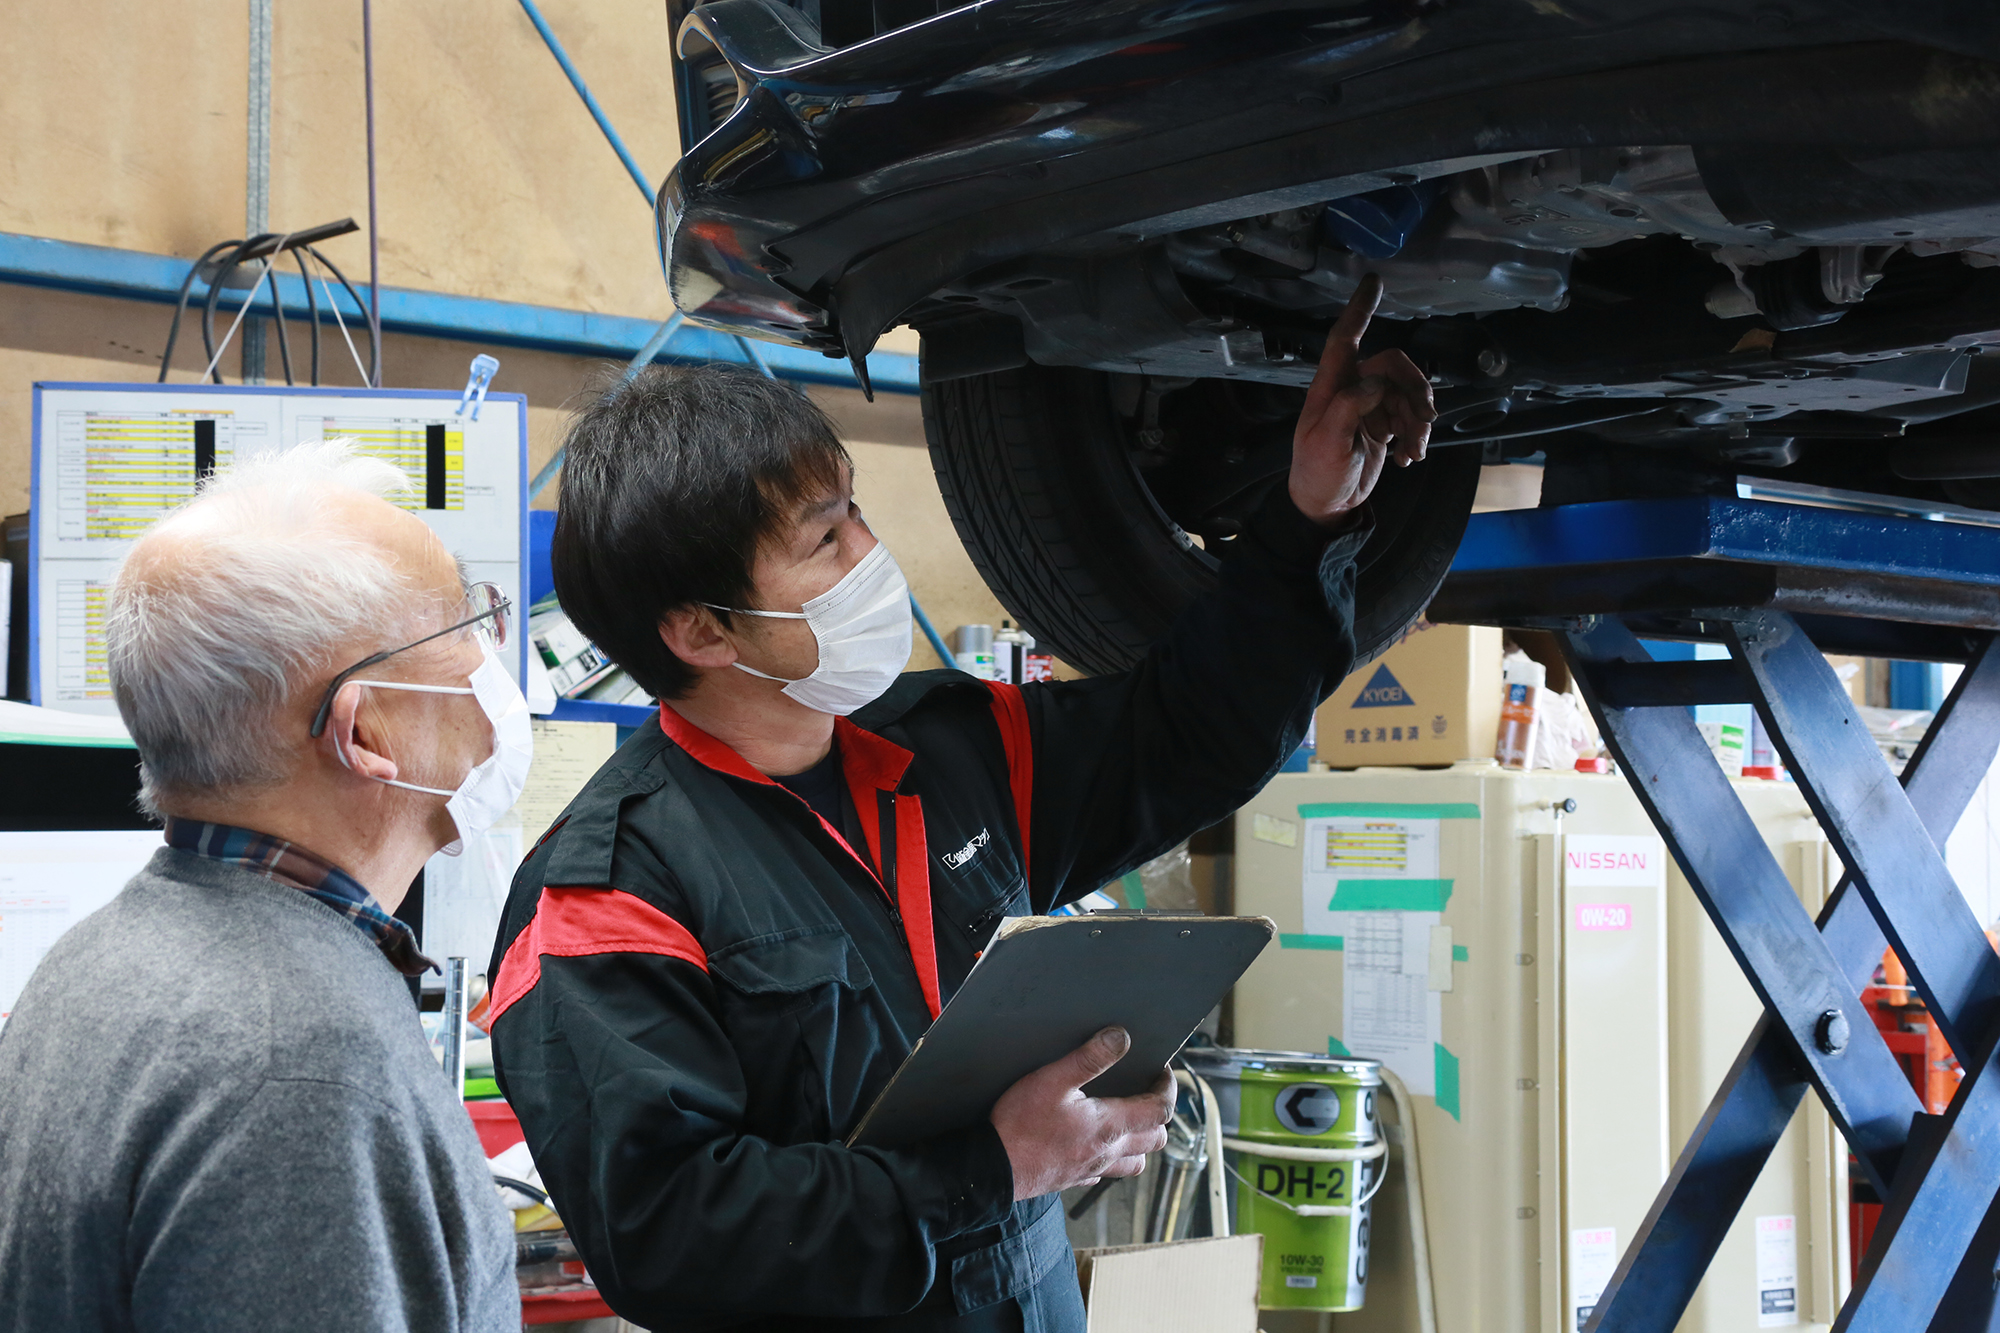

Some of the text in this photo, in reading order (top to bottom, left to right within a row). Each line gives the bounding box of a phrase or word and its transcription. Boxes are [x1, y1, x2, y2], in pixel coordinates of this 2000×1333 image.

[1363, 687, 1403, 702] KYOEI
[1567, 852, 1646, 869] NISSAN
[1581, 907, 1626, 927] 0W-20
[1257, 1164, 1345, 1199] DH-2
[1280, 1254, 1325, 1267] 10W-30
